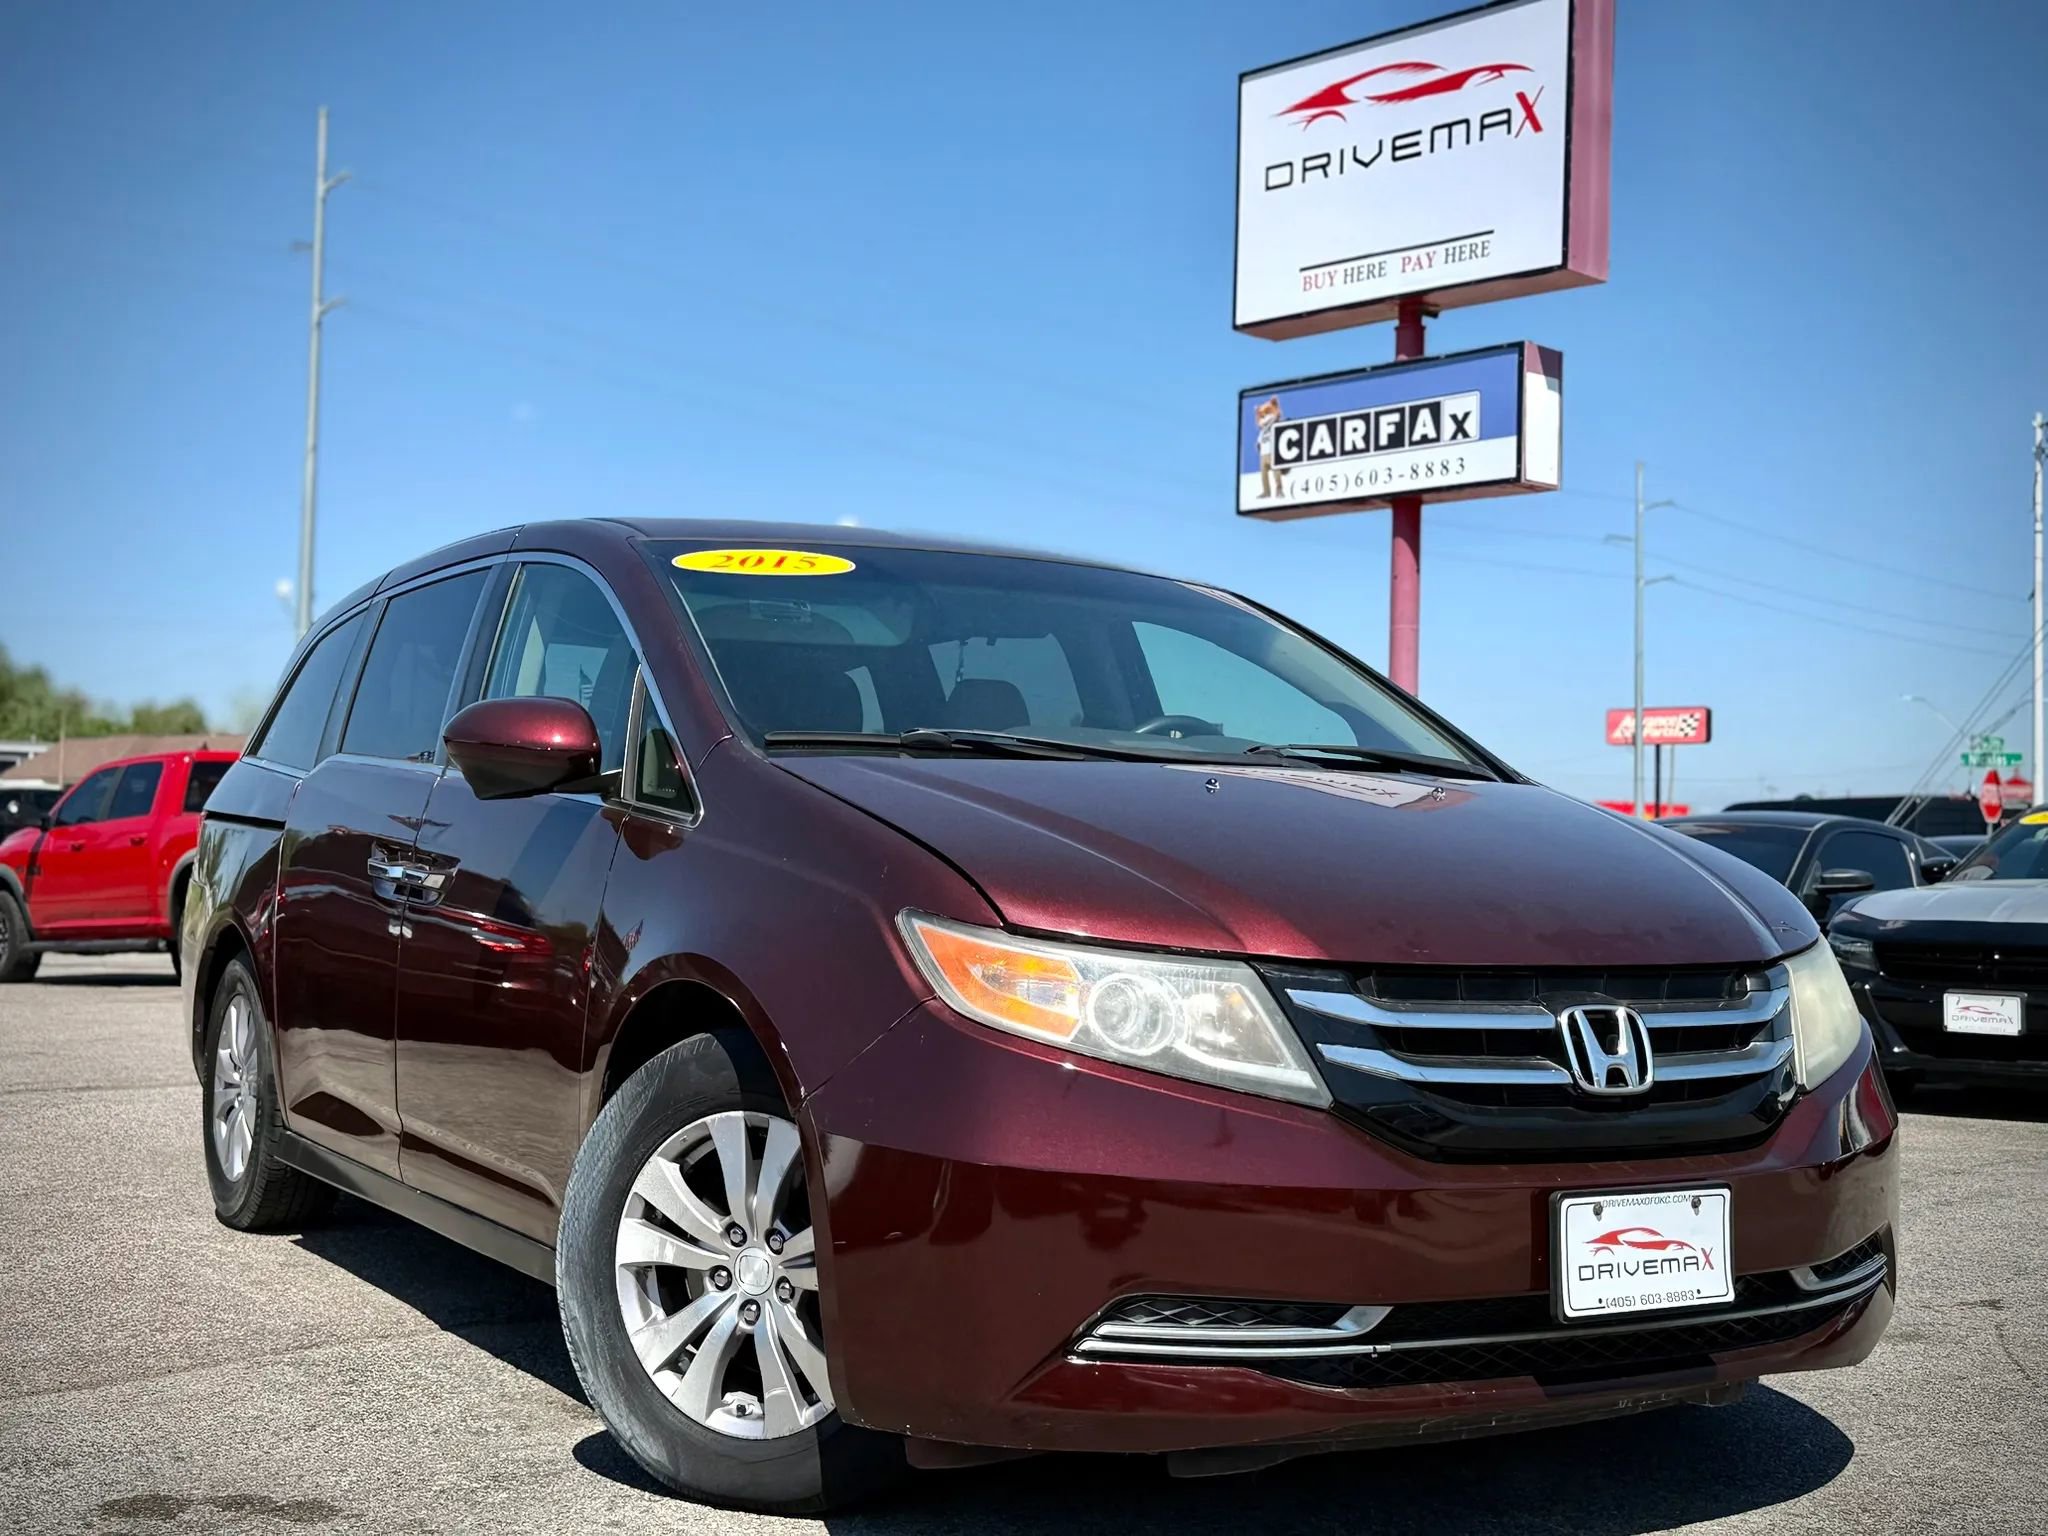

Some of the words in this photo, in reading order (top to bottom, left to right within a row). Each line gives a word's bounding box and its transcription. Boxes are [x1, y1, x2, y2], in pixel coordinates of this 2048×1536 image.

[1264, 85, 1545, 192] DRIVEMAX
[1302, 269, 1338, 292] BUY
[1343, 260, 1388, 285] HERE
[1400, 250, 1437, 274] PAY
[1443, 239, 1492, 265] HERE
[1277, 407, 1473, 462] CARFAX
[1289, 456, 1466, 500] (405)603-8883
[708, 555, 820, 569] 2015
[1951, 1014, 2014, 1025] DRIVEMAX
[1578, 1247, 1715, 1281] DRIVEMAX
[1606, 1295, 1636, 1309] (405)
